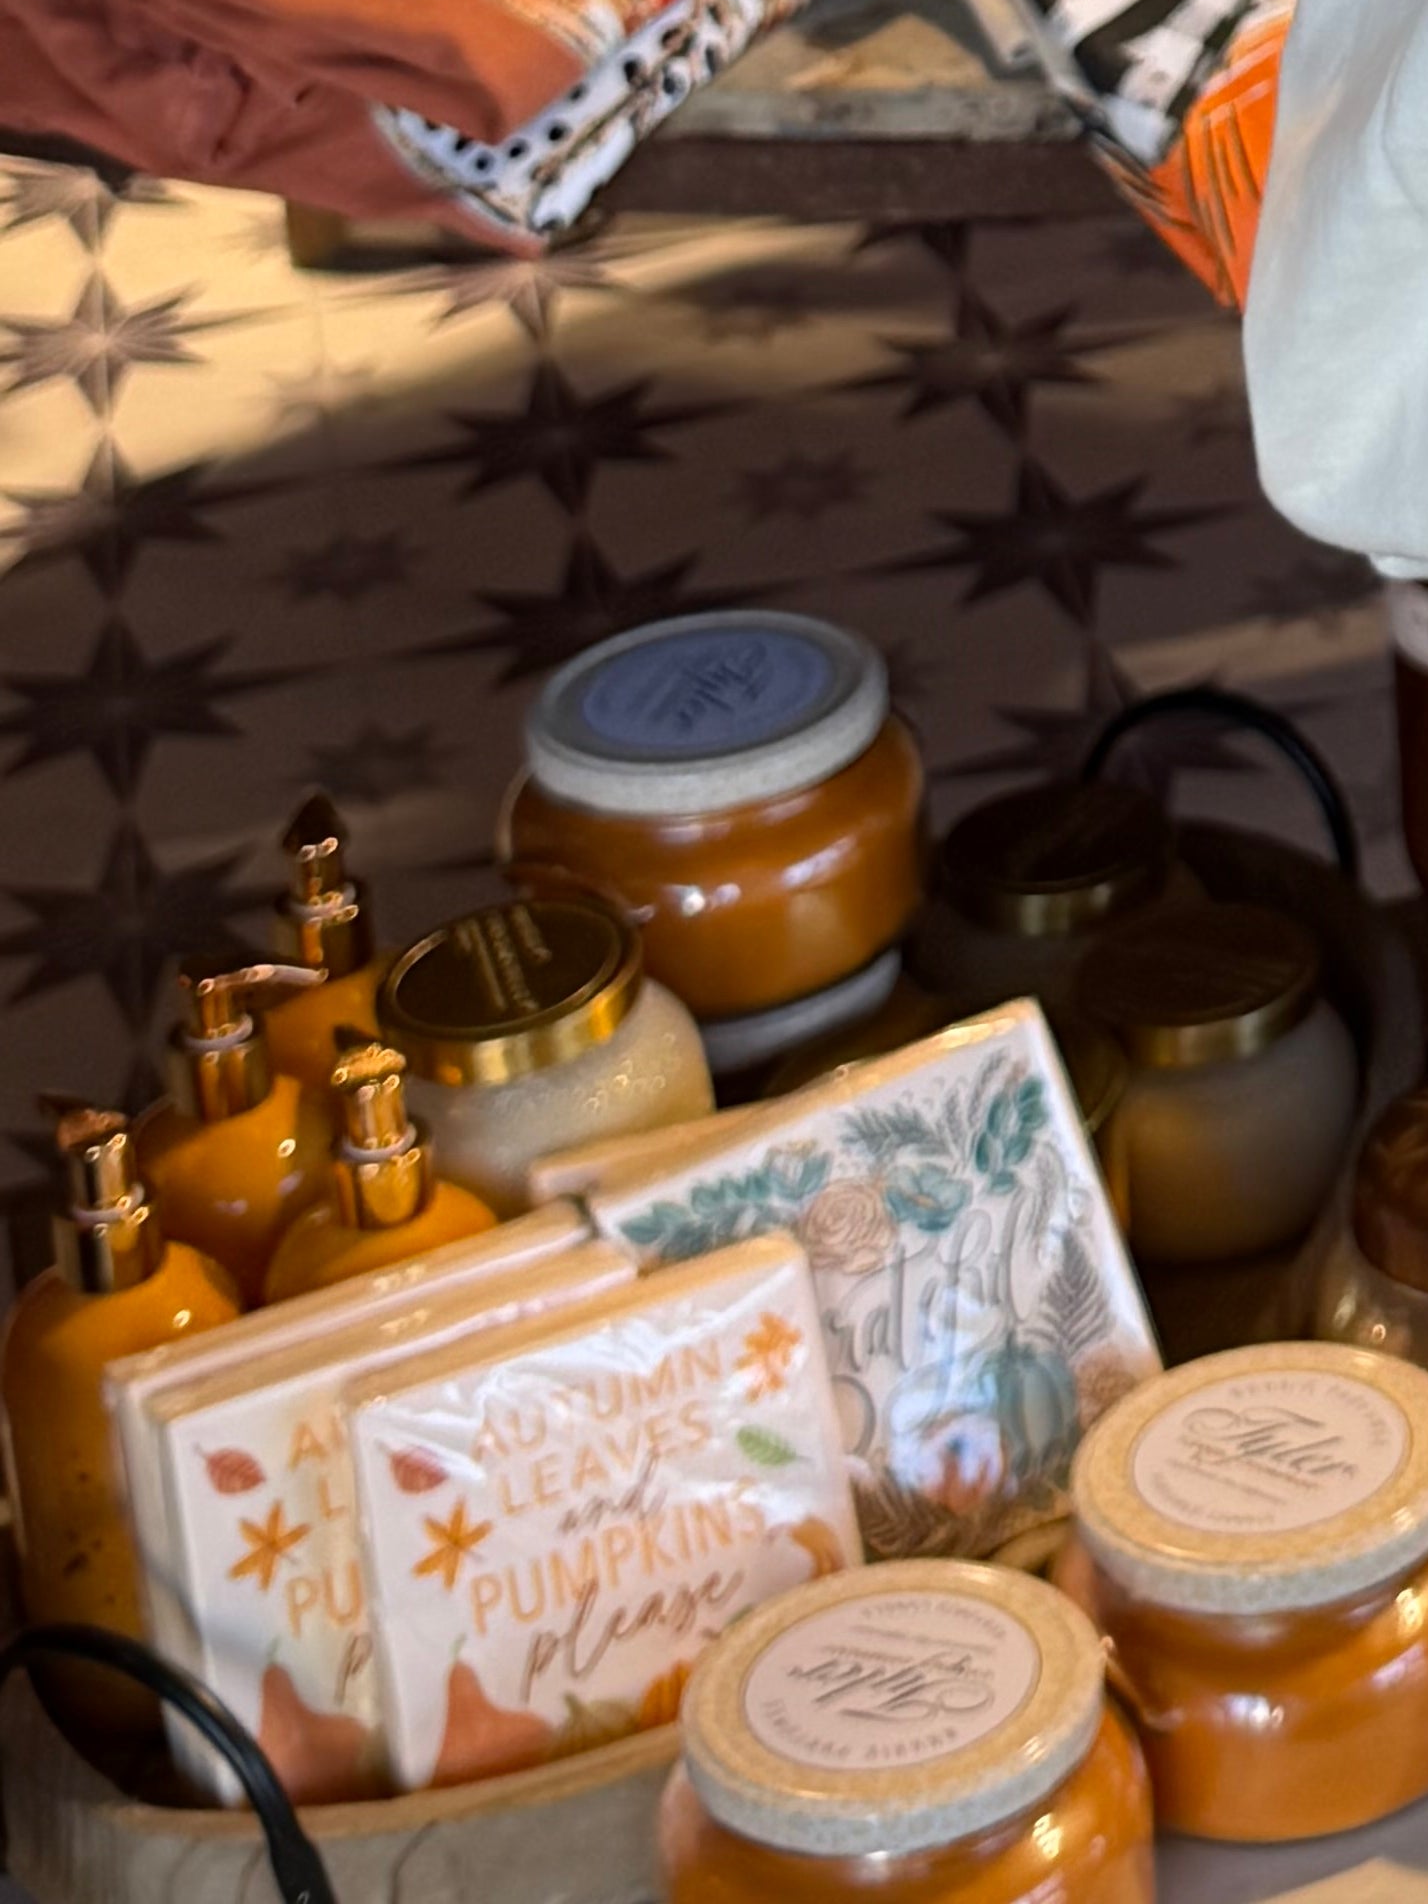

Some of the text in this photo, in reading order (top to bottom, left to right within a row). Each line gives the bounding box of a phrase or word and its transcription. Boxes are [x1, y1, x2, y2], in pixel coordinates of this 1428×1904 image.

[472, 1337, 725, 1464] AUTUMN
[499, 1403, 713, 1517] LEAVES
[469, 1497, 767, 1636] PUMPKINS
[520, 1571, 745, 1704] please
